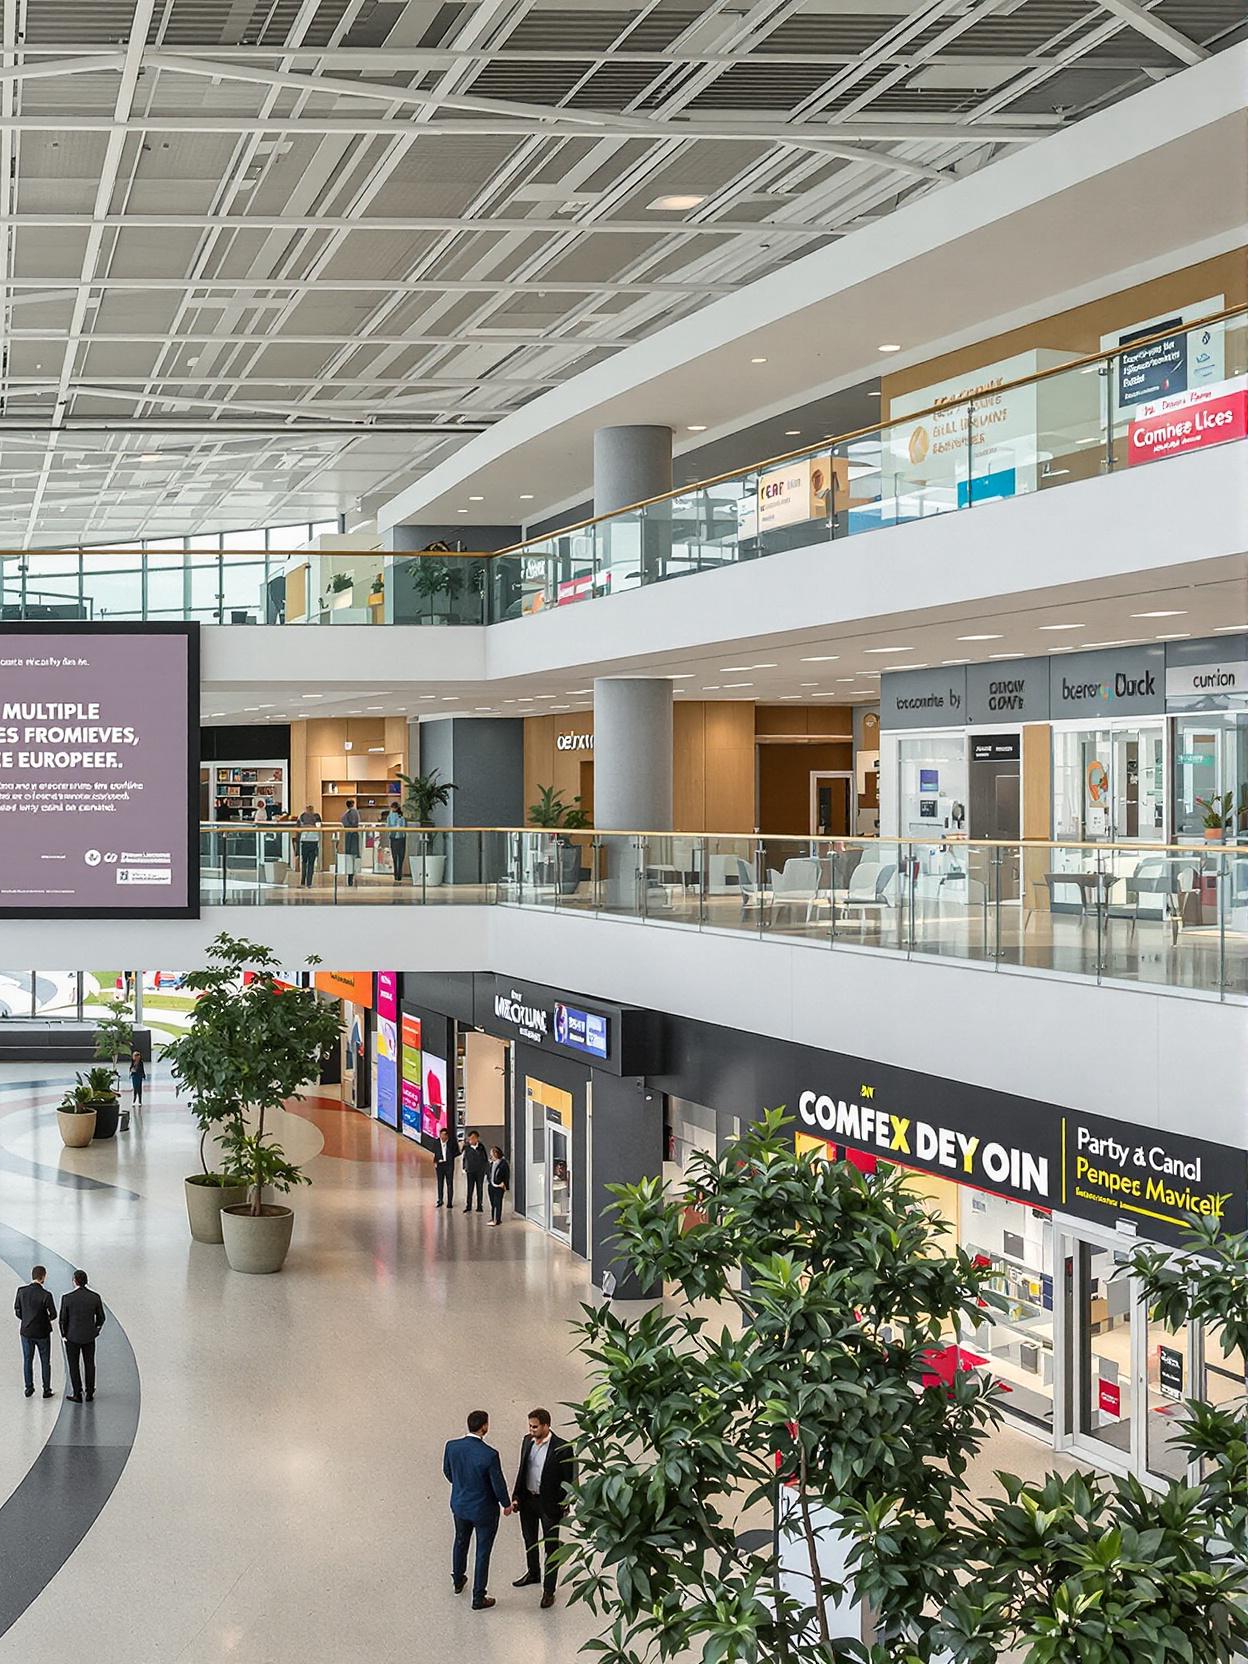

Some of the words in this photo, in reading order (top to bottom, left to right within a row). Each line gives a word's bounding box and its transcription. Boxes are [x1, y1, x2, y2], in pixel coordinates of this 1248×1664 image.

[2, 703, 99, 720] MULTIPLE
[24, 727, 140, 746] FROMIEVES,
[798, 1090, 911, 1155] COMFEX
[916, 1121, 980, 1174] DEY
[982, 1141, 1049, 1197] OIN
[1077, 1126, 1129, 1168] Party
